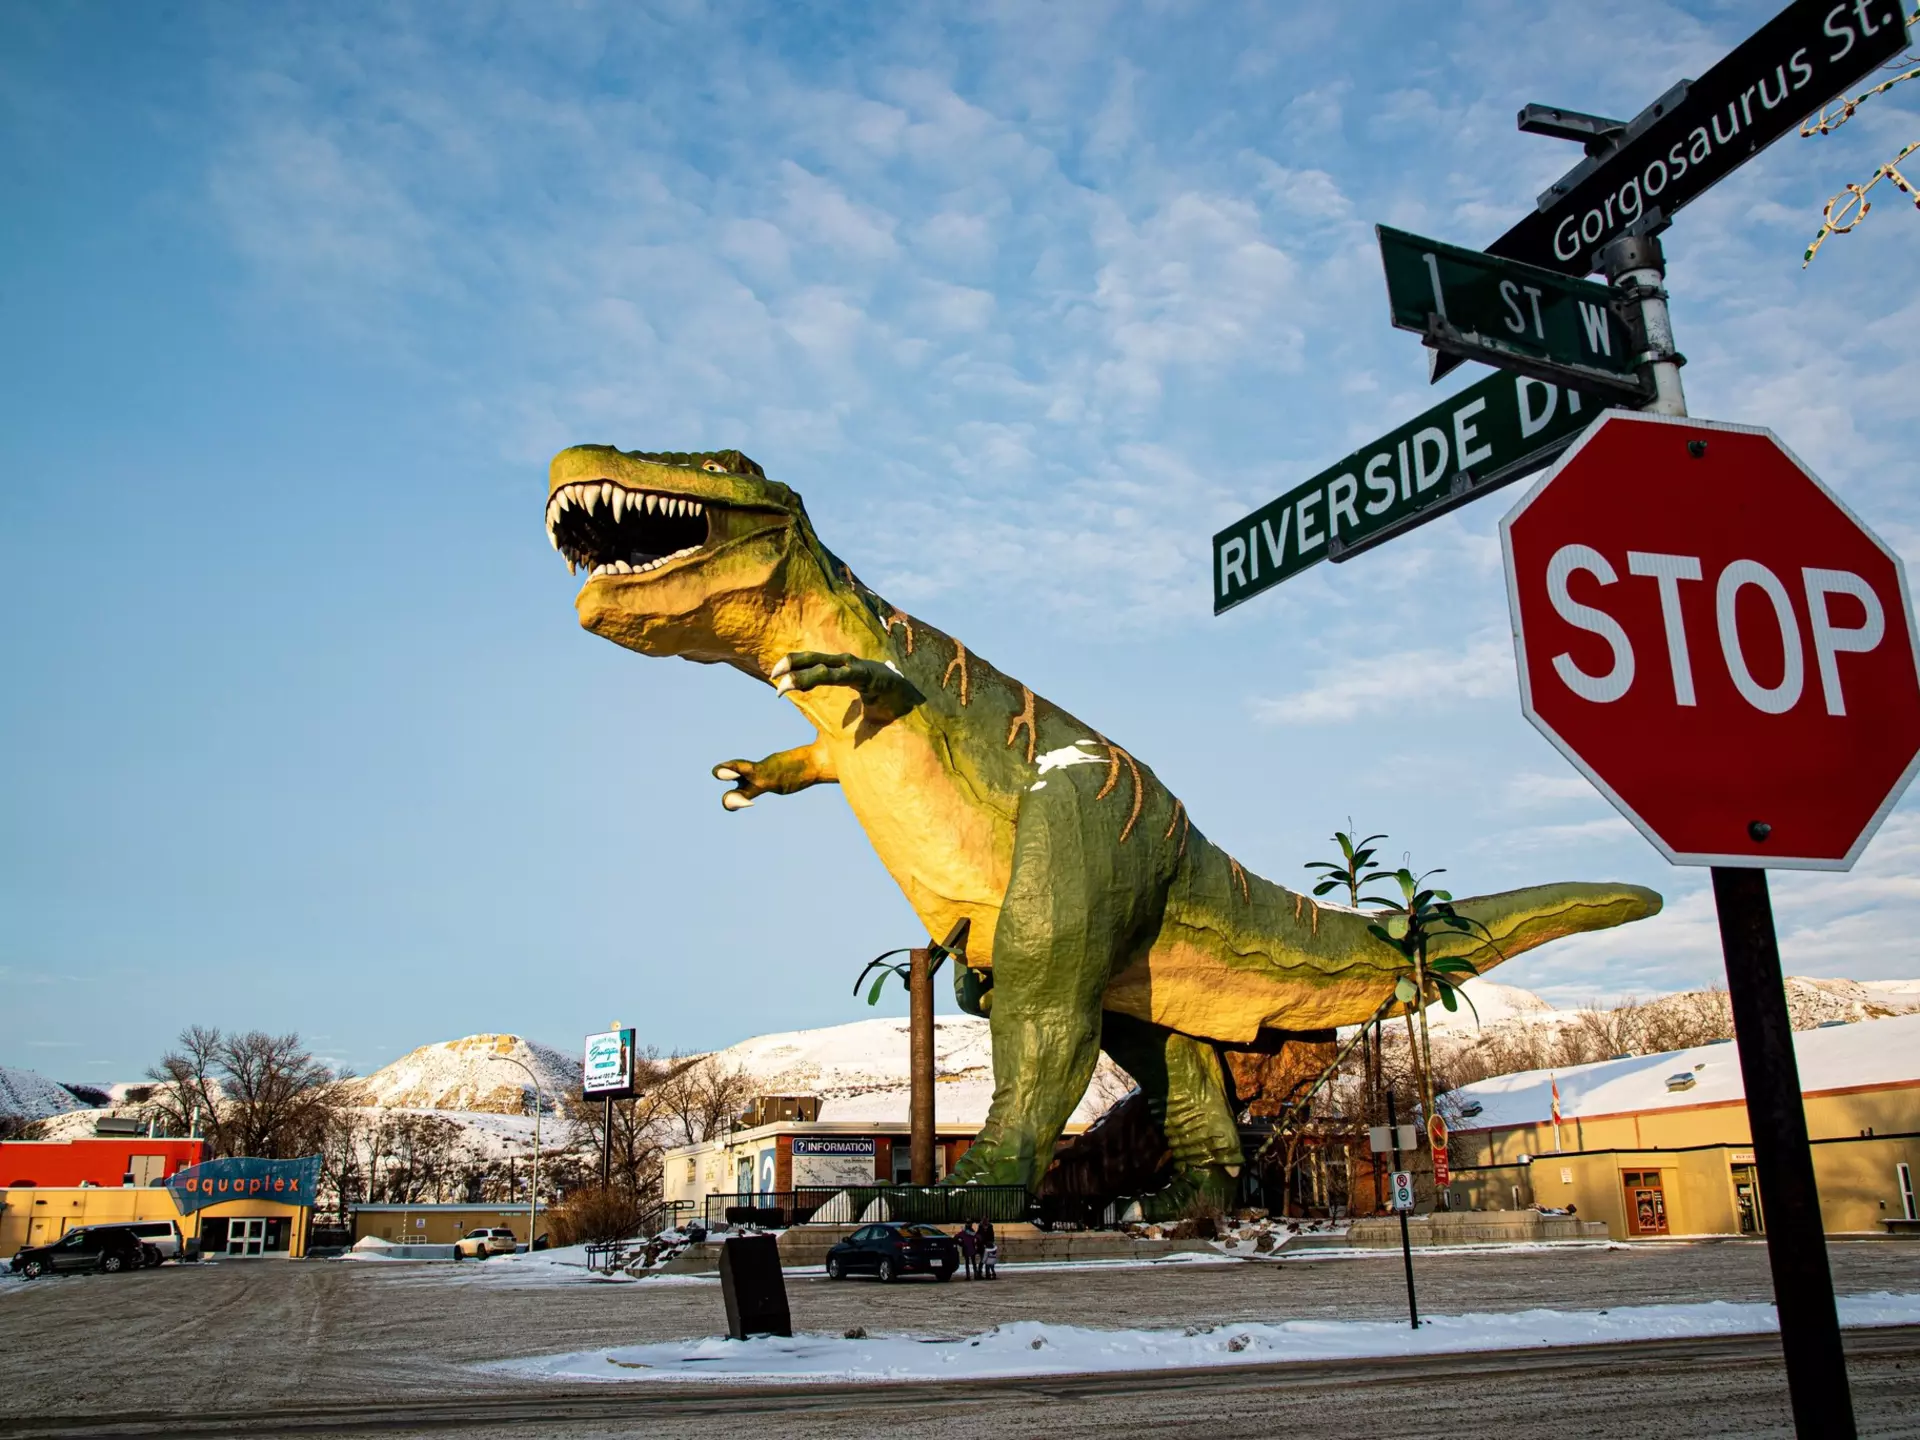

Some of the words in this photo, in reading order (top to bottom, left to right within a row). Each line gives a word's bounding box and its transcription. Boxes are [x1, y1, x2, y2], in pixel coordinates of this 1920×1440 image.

[1553, 48, 1812, 261] Gorgosaurus
[1823, 0, 1892, 62] St.
[1422, 252, 1447, 322] 1
[1499, 279, 1545, 339] ST
[1578, 301, 1611, 356] W
[1220, 396, 1493, 596] RIVERSIDE
[1546, 543, 1886, 717] STOP
[185, 1175, 300, 1196] aquaplex
[808, 1142, 872, 1152] INFORMATION
